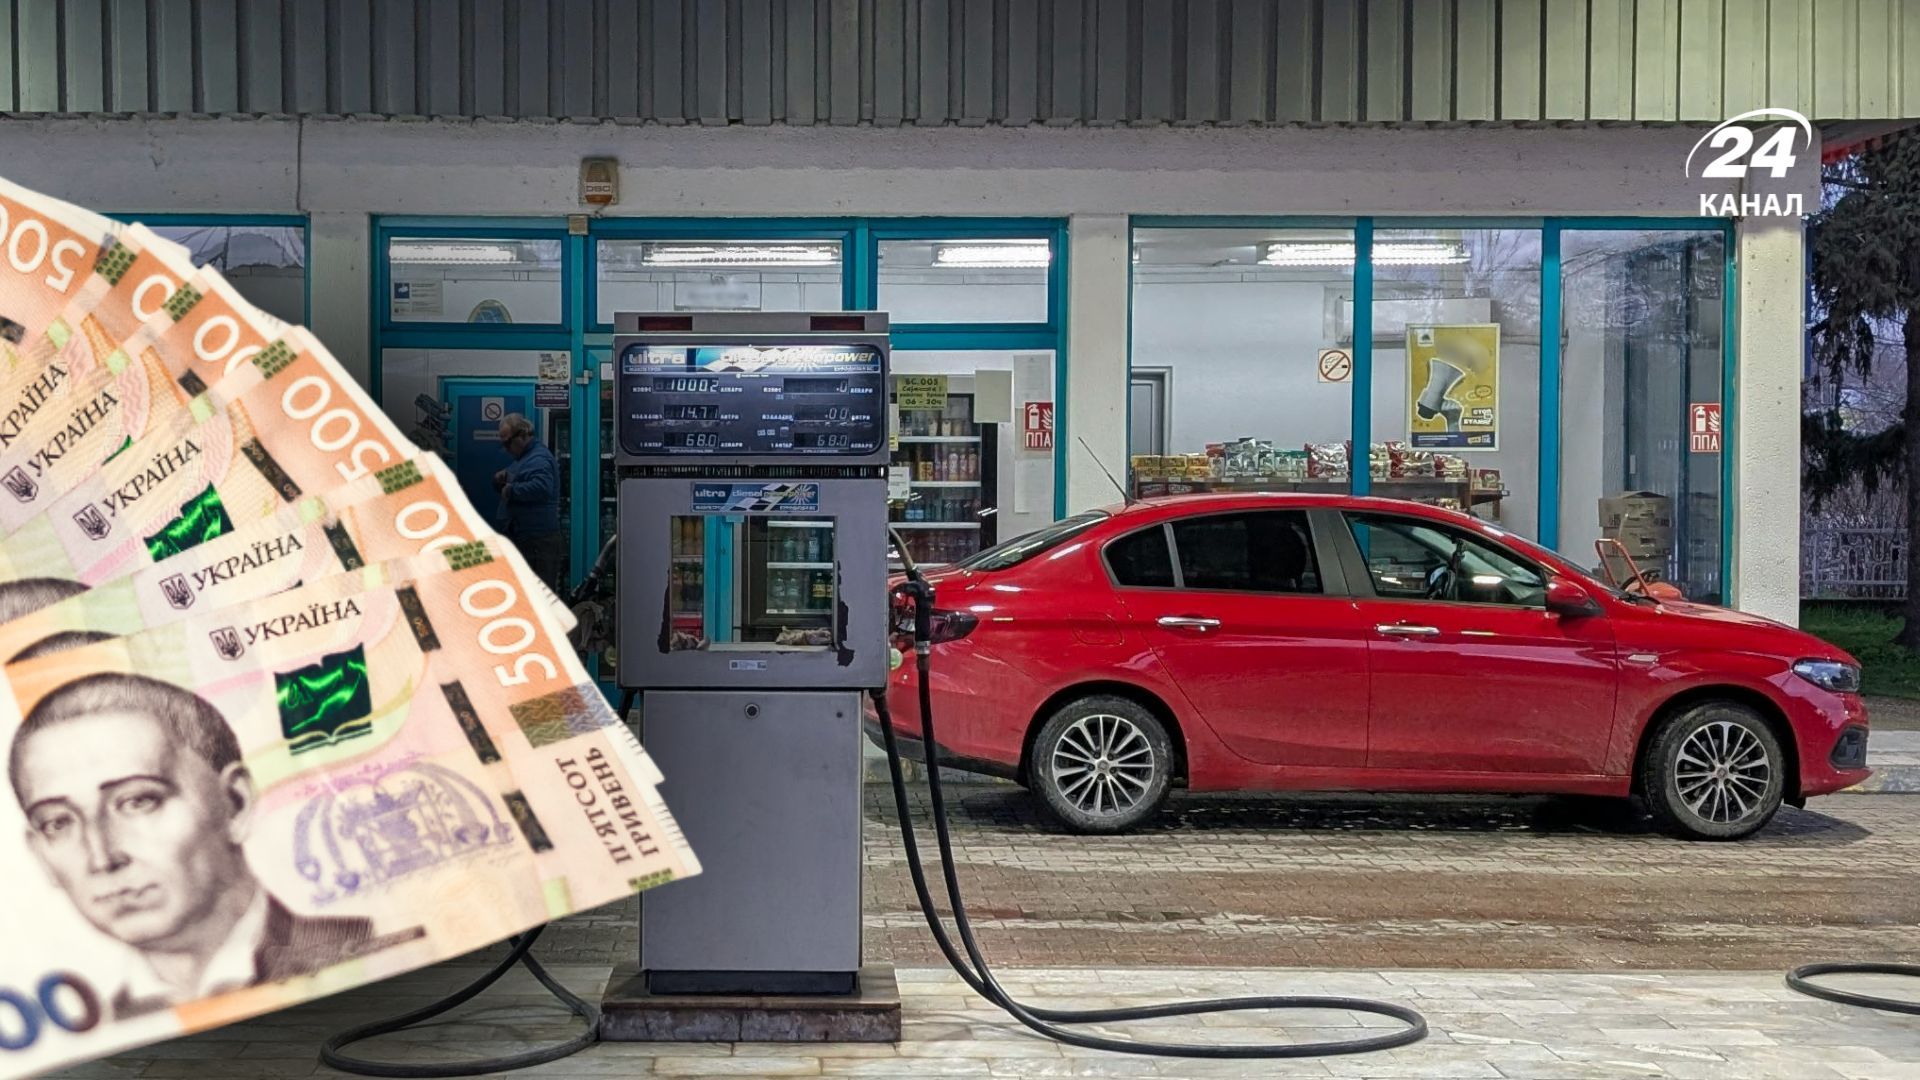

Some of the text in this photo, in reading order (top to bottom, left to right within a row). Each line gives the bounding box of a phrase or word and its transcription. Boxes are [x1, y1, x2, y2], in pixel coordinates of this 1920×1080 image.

[0, 202, 86, 294] 50
[628, 350, 686, 364] ultra
[671, 379, 719, 393] 10002
[27, 390, 119, 478] УКРАЇНА
[282, 375, 390, 481] 500
[686, 433, 717, 447] 68.0
[817, 435, 848, 447] 68.0
[1026, 431, 1051, 447] ППА
[1692, 434, 1719, 450] ППА
[103, 438, 201, 517] УКРАЇНА
[192, 533, 304, 591] УКРАЇНА
[243, 599, 361, 645] УКРАЇНА
[459, 579, 558, 688] 500
[586, 747, 660, 858] ГРИВЕНЬ
